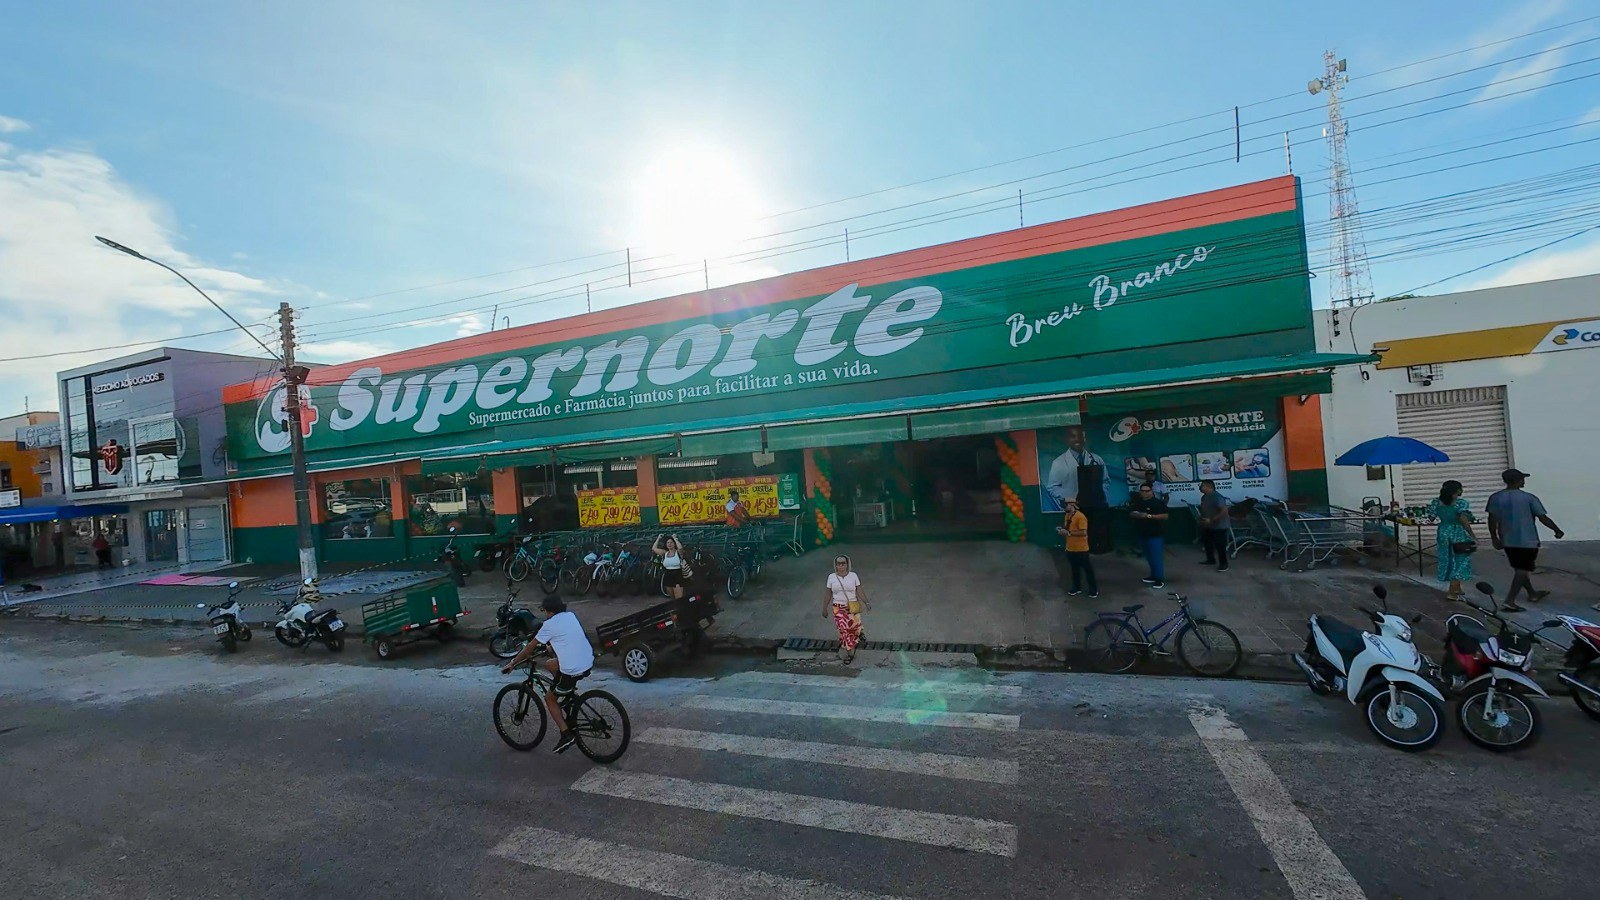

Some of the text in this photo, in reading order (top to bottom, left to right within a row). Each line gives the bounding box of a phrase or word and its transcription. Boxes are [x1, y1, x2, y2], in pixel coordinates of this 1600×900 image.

[1006, 246, 1216, 348] Breu Branco
[121, 371, 160, 388] ADVOGADOS
[329, 283, 943, 433] Supernorte
[469, 359, 878, 427] Supermercado e Farmácia juntos para facilitar a sua vida.
[1143, 410, 1265, 431] SUPERNORTE
[1213, 423, 1266, 434] Farmácia
